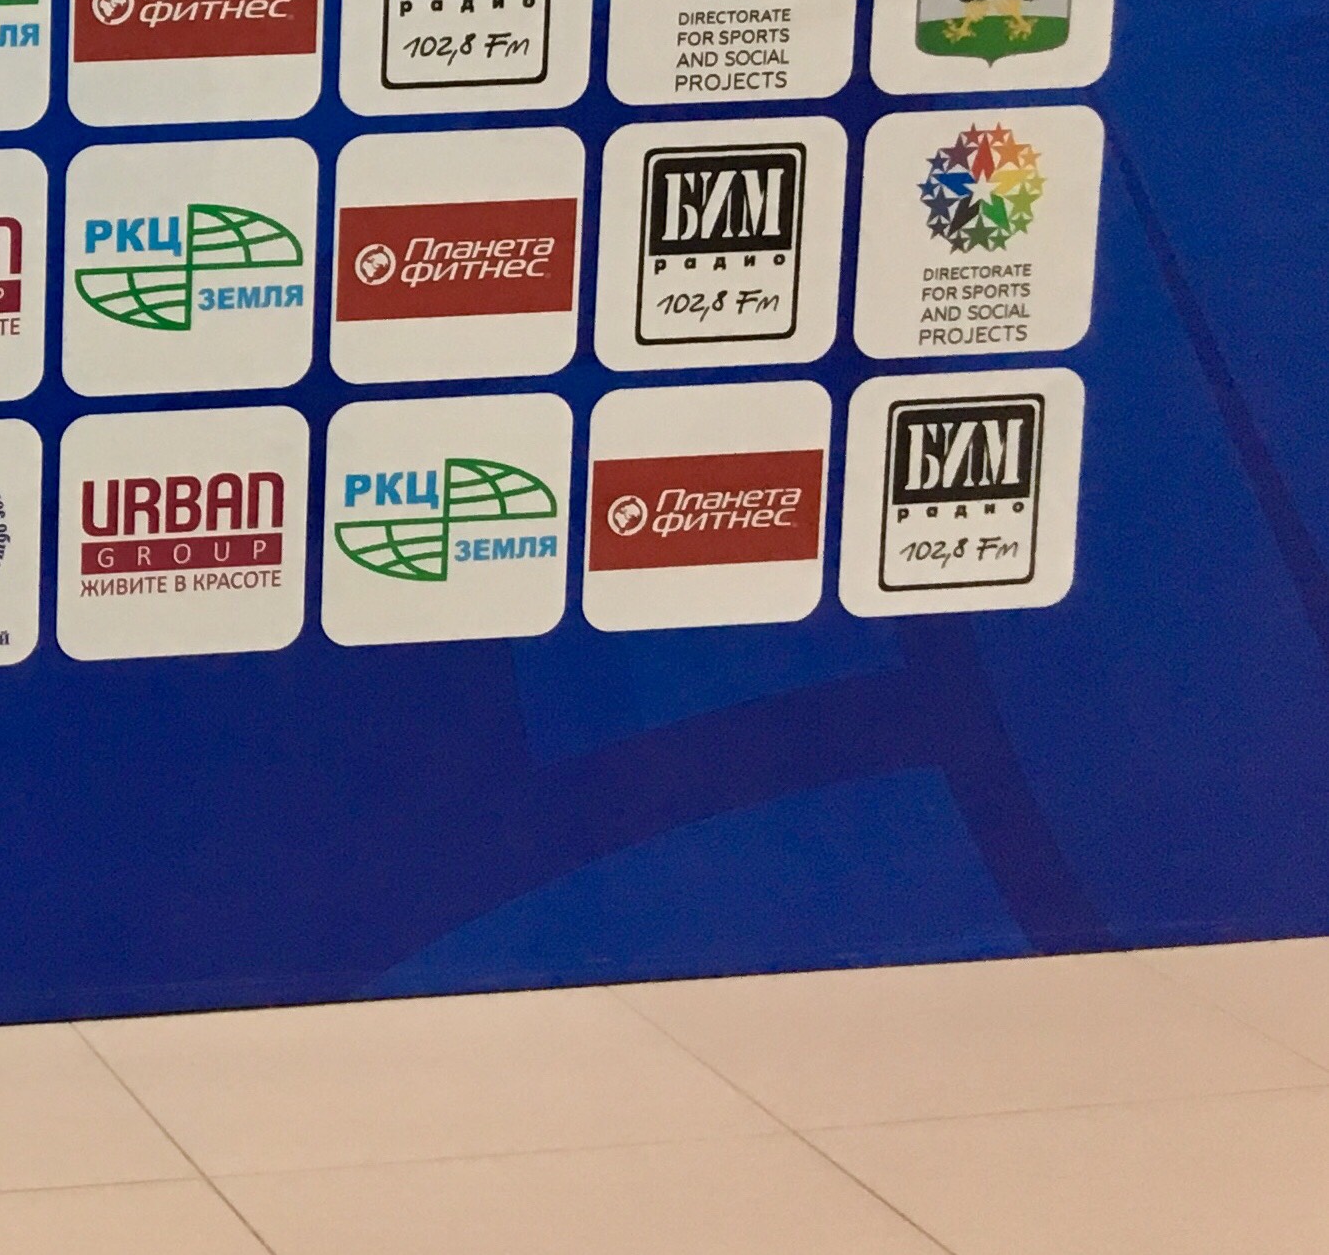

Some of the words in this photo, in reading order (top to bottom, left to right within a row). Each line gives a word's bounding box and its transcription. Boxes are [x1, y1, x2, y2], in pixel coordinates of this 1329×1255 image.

[677, 8, 791, 26] DIRECTORATE
[401, 33, 476, 68] 102,8
[676, 30, 714, 47] FOR
[717, 28, 790, 45] SPORTS
[675, 51, 718, 68] AND
[723, 48, 789, 67] SOCIAL
[673, 71, 787, 93] PROJECTS
[659, 168, 784, 242] БИМ
[85, 216, 183, 262] РКЦ
[404, 232, 554, 262] Планета
[400, 256, 548, 289] фитнес
[652, 254, 785, 276] радио
[198, 284, 304, 312] ЗЕМЛЯ
[654, 290, 727, 325] 102,8
[903, 419, 1025, 491] БИМ
[82, 470, 285, 539] URBAN
[344, 470, 440, 515] РКЦ
[654, 482, 801, 512] Планета
[650, 506, 794, 538] фитнес
[896, 502, 1025, 524] радио
[98, 539, 267, 569] GROUP
[453, 534, 557, 562] ЗЕМЛЯ
[897, 537, 968, 571] 102,8
[81, 576, 169, 598] ЖИВИТЕ
[175, 575, 187, 592] В
[194, 570, 282, 591] КРАСОТЕ
